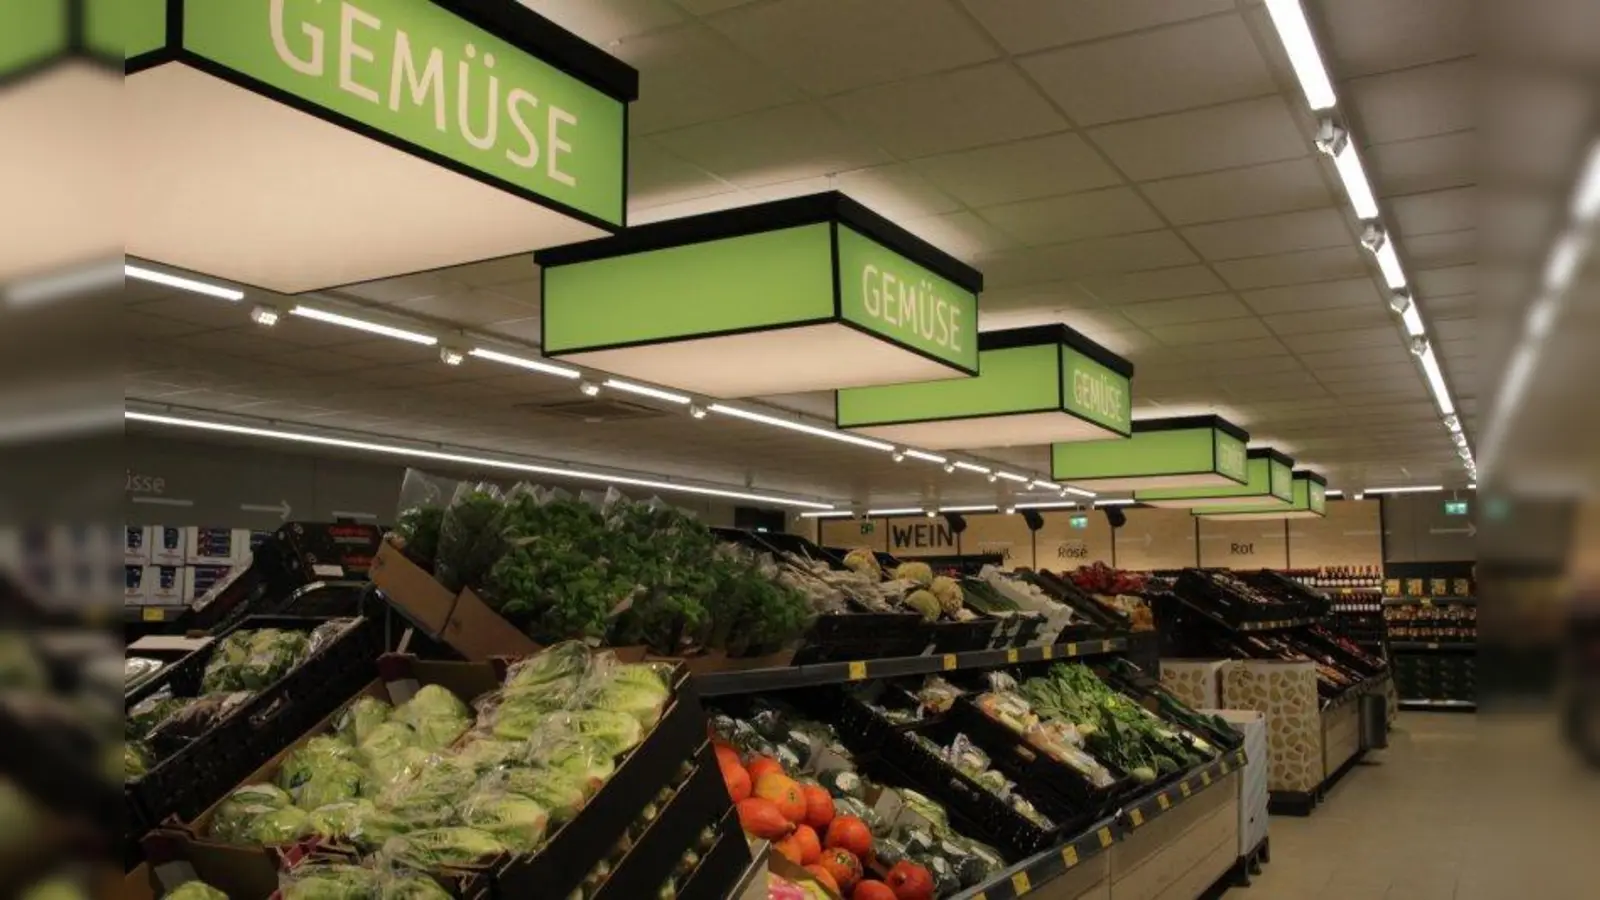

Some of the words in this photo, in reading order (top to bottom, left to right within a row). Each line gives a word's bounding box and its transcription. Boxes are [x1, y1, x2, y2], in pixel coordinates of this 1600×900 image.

[269, 0, 578, 187] GEMÜSE
[862, 263, 962, 352] GEMÜSE
[892, 523, 954, 549] WEIN
[1230, 542, 1255, 556] Rot
